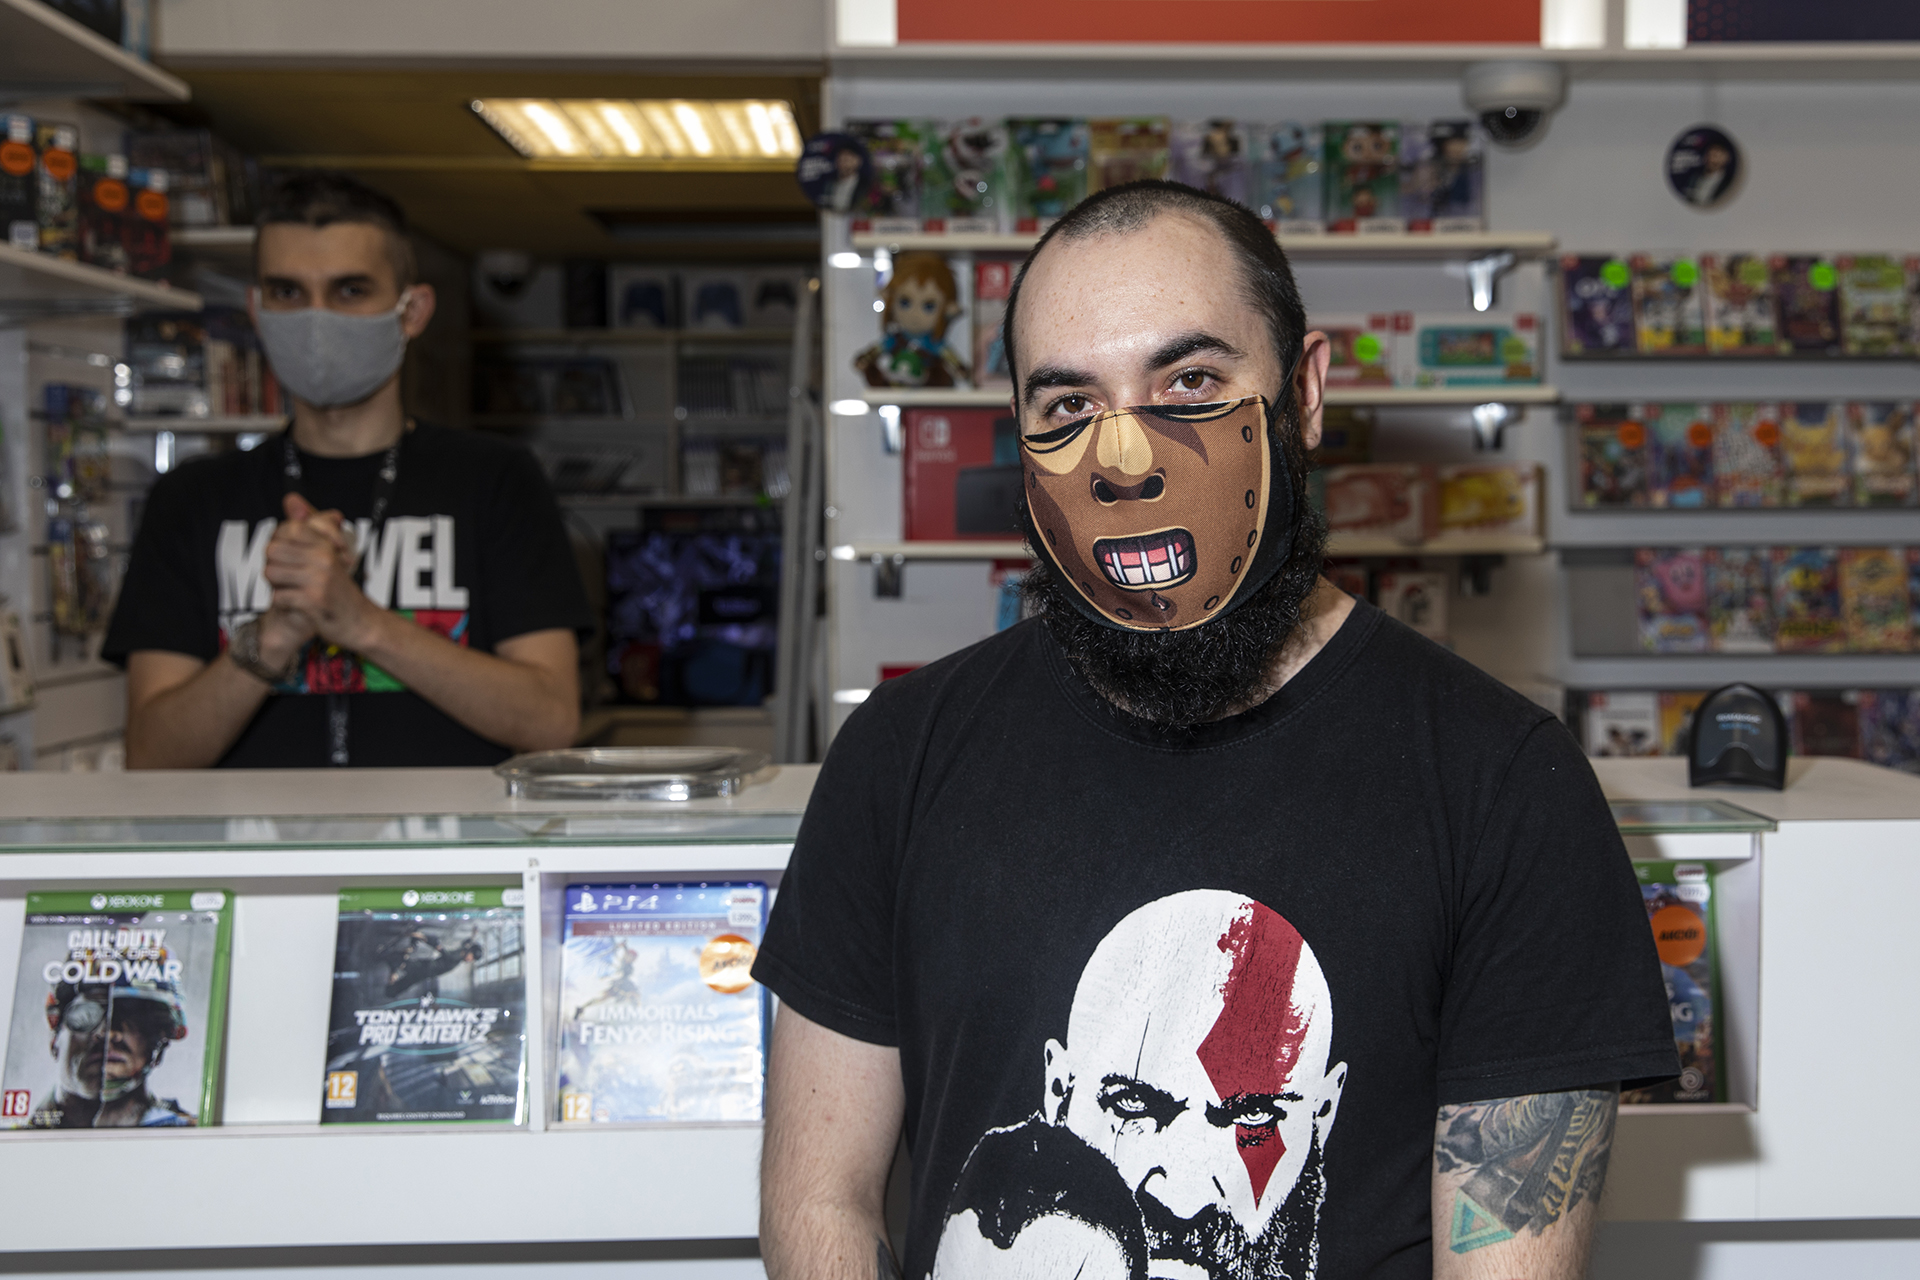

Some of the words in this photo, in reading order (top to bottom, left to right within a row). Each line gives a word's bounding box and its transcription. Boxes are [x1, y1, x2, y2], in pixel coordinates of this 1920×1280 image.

[216, 515, 470, 610] MVEL
[603, 895, 659, 911] PS4
[609, 921, 661, 931] LIMITED
[665, 921, 717, 930] EDITION
[68, 929, 111, 949] CALL
[115, 929, 166, 949] DUTY
[72, 949, 124, 960] BLACK
[127, 949, 160, 960] OPS
[43, 960, 121, 983] COLD
[121, 959, 183, 982] WAR
[354, 1010, 416, 1025] TONY
[416, 1007, 500, 1023] HAWK'S
[599, 1004, 718, 1020] IMMORTALS
[359, 1024, 397, 1046] PRO
[396, 1023, 463, 1045] SKATER
[579, 1022, 654, 1045] FENYX
[660, 1022, 736, 1044] RISING
[329, 1076, 355, 1098] 12
[4, 1091, 29, 1115] 18
[566, 1096, 590, 1119] 12
